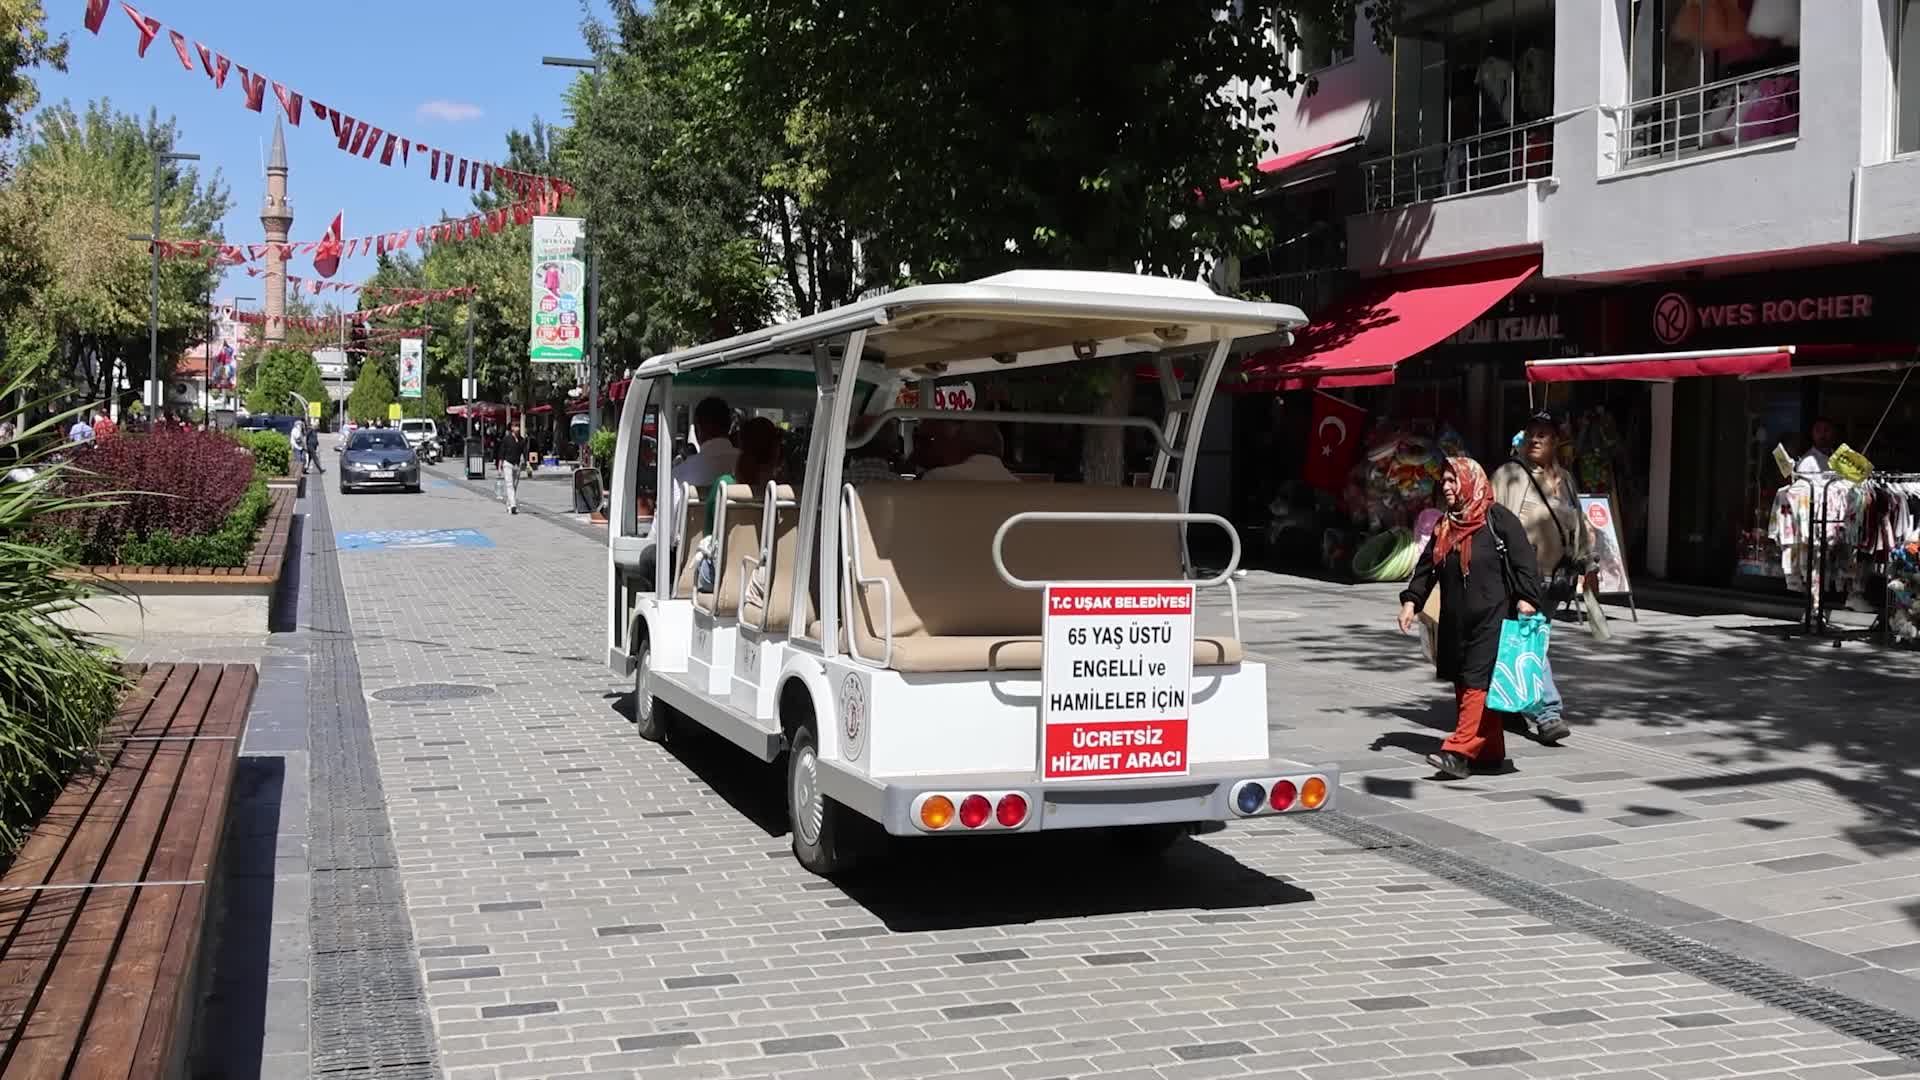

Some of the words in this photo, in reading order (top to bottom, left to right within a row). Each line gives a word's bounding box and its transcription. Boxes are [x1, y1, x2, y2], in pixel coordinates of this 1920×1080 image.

[1697, 303, 1754, 328] YVES
[1761, 294, 1873, 323] ROCHER
[1051, 596, 1072, 609] T.C
[1074, 596, 1112, 611] UŞAK
[1114, 593, 1190, 609] BELEDİYESİ
[1067, 627, 1087, 645] 65
[1092, 626, 1123, 650] YAŞ
[1129, 621, 1172, 645] ÜSTÜ
[1072, 653, 1143, 678] ENGELLİ
[1148, 661, 1166, 676] ve
[1050, 687, 1146, 712] HAMİLELER
[1151, 685, 1185, 714] İÇİN
[1072, 724, 1163, 748] ÜCRETSİZ
[1051, 751, 1122, 773] HİZMET
[1125, 750, 1181, 769] ARACI
